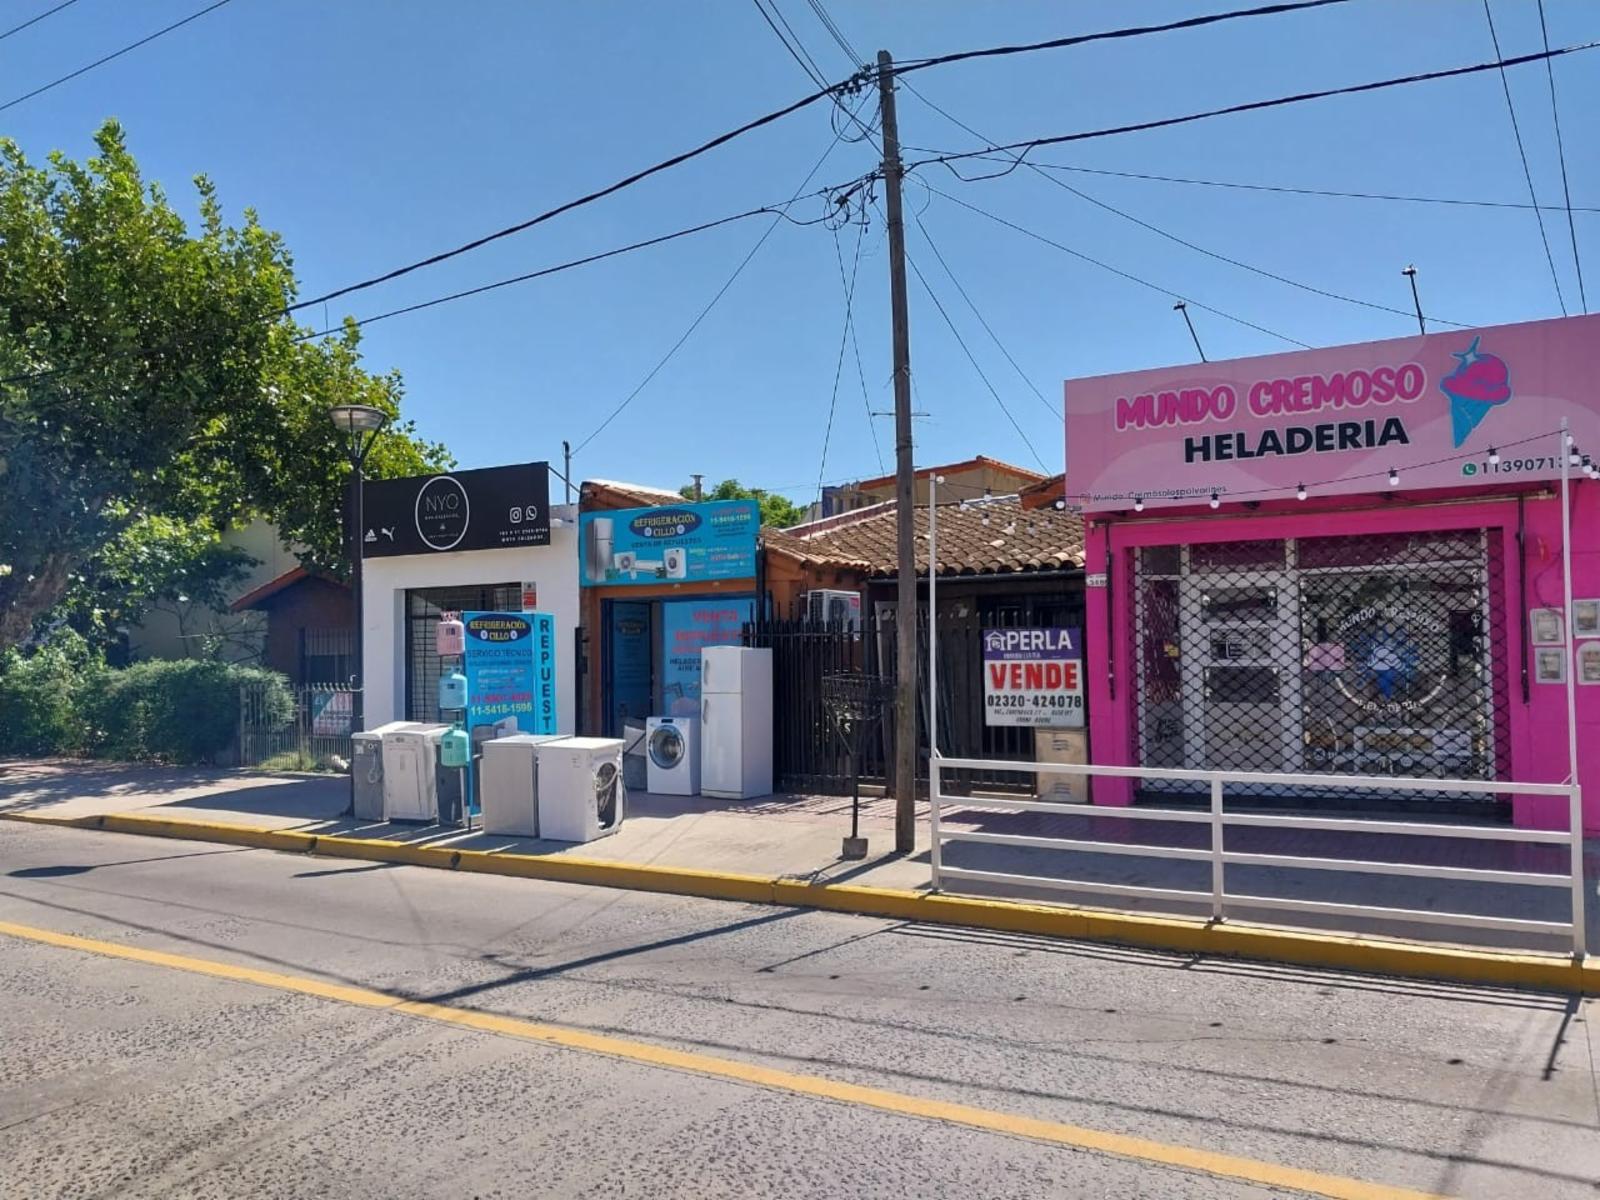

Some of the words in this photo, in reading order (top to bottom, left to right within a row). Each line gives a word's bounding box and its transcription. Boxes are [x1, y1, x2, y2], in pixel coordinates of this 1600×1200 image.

[1116, 386, 1236, 430] MUNDO
[1248, 361, 1426, 418] CREMOSO
[1184, 417, 1410, 464] HELADERIA
[425, 493, 459, 512] NYO
[653, 526, 676, 537] CILLO
[489, 632, 510, 640] CILLO
[1006, 630, 1073, 651] PERLA
[990, 663, 1078, 690] VENDE
[987, 695, 1082, 708] 02320-424078
